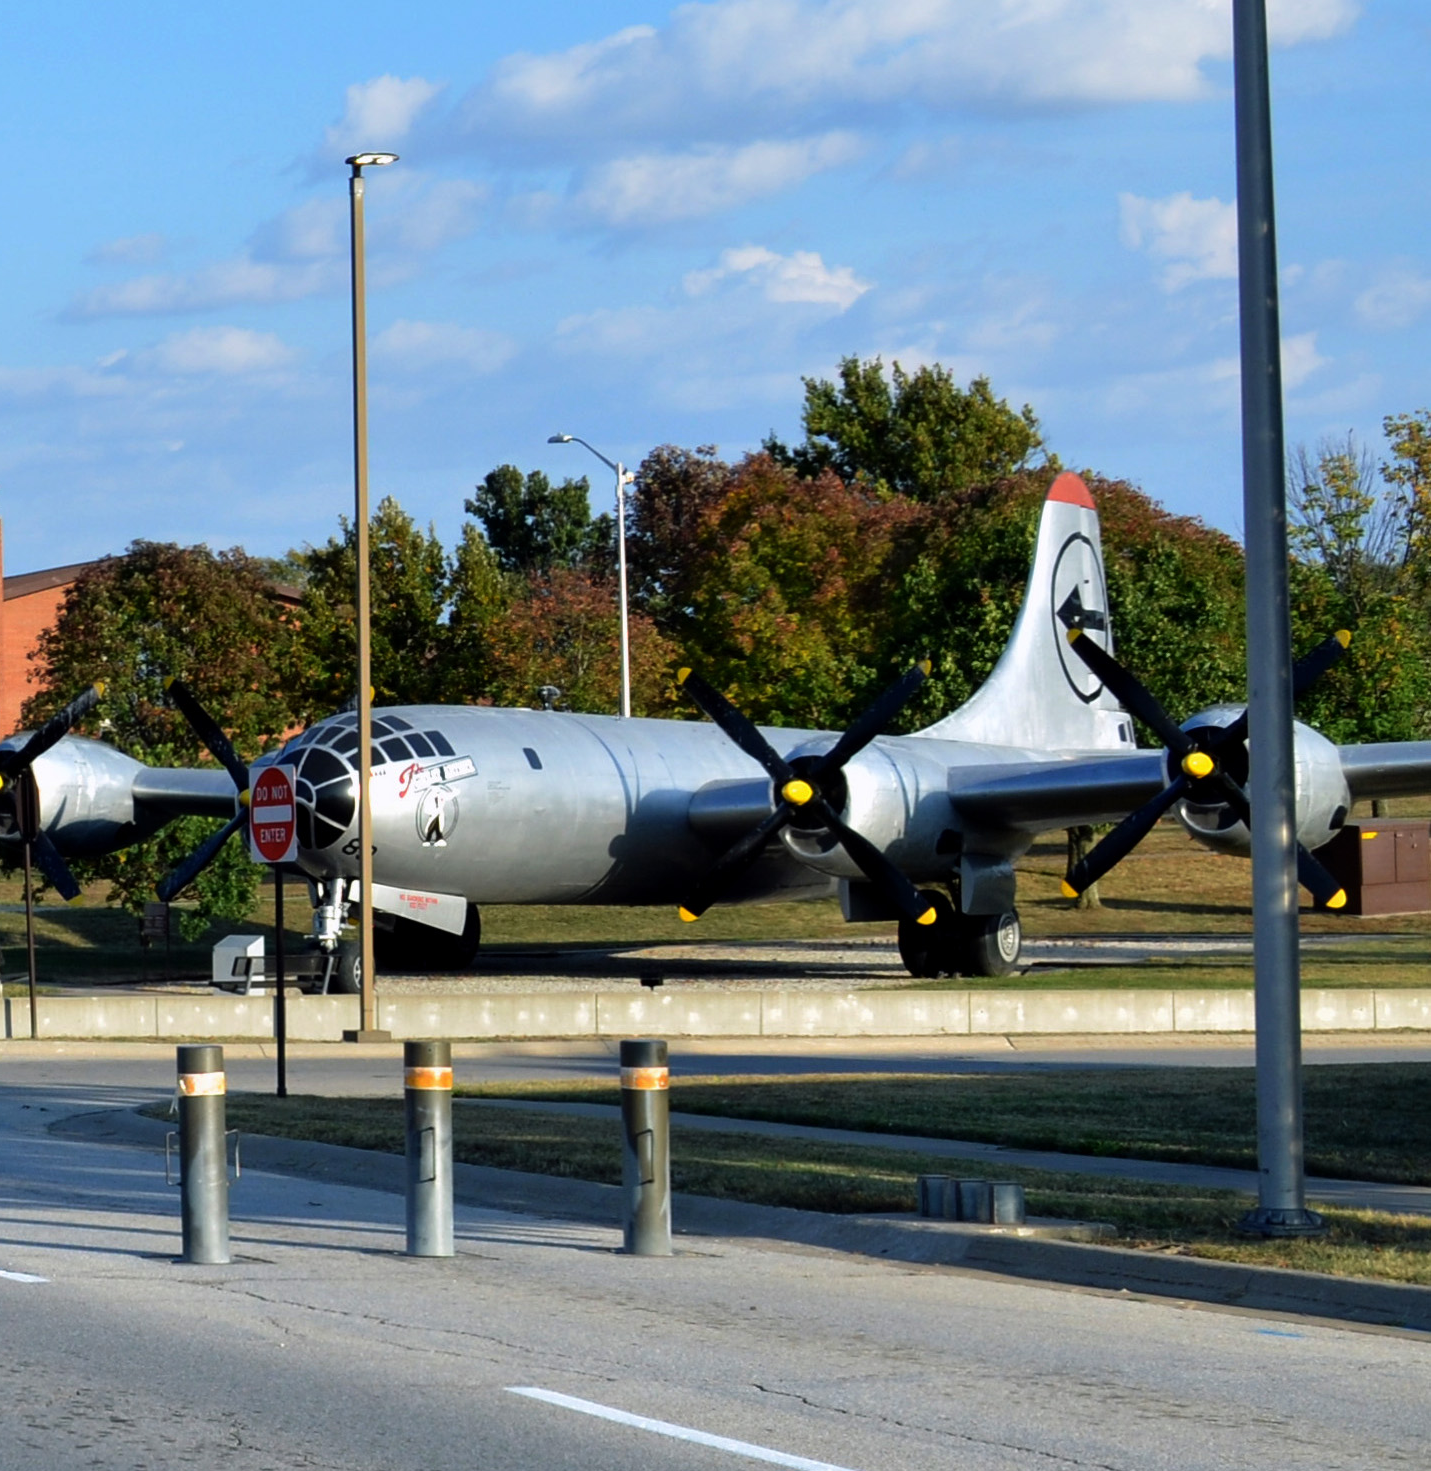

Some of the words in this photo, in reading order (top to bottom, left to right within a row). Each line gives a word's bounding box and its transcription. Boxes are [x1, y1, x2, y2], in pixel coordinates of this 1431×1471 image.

[256, 786, 268, 801] DO
[272, 784, 288, 800] NOT
[260, 828, 286, 844] ENTER
